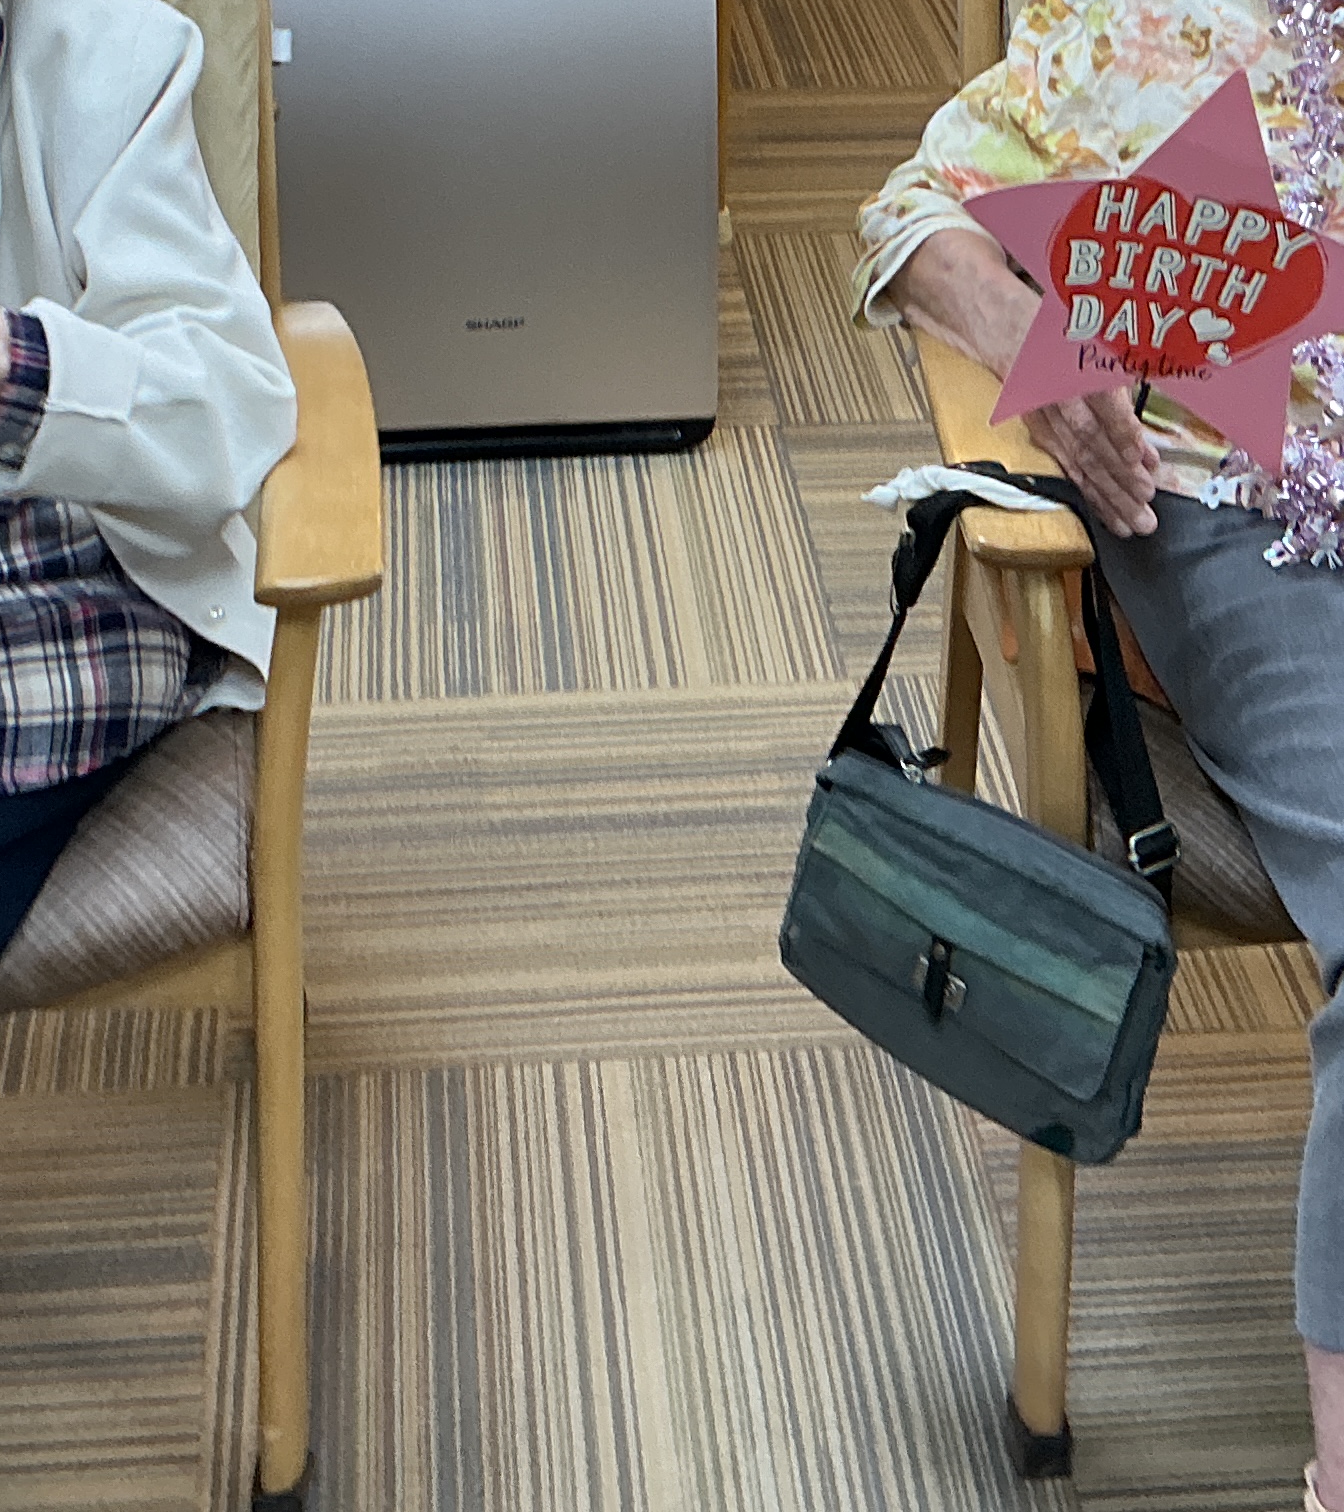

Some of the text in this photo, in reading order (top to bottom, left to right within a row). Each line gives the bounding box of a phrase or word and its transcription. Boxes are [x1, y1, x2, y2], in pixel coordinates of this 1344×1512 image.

[1094, 184, 1317, 270] HAPPY
[1065, 239, 1267, 314] BIRTH
[465, 317, 525, 330] SHARP
[1066, 294, 1185, 348] DAY
